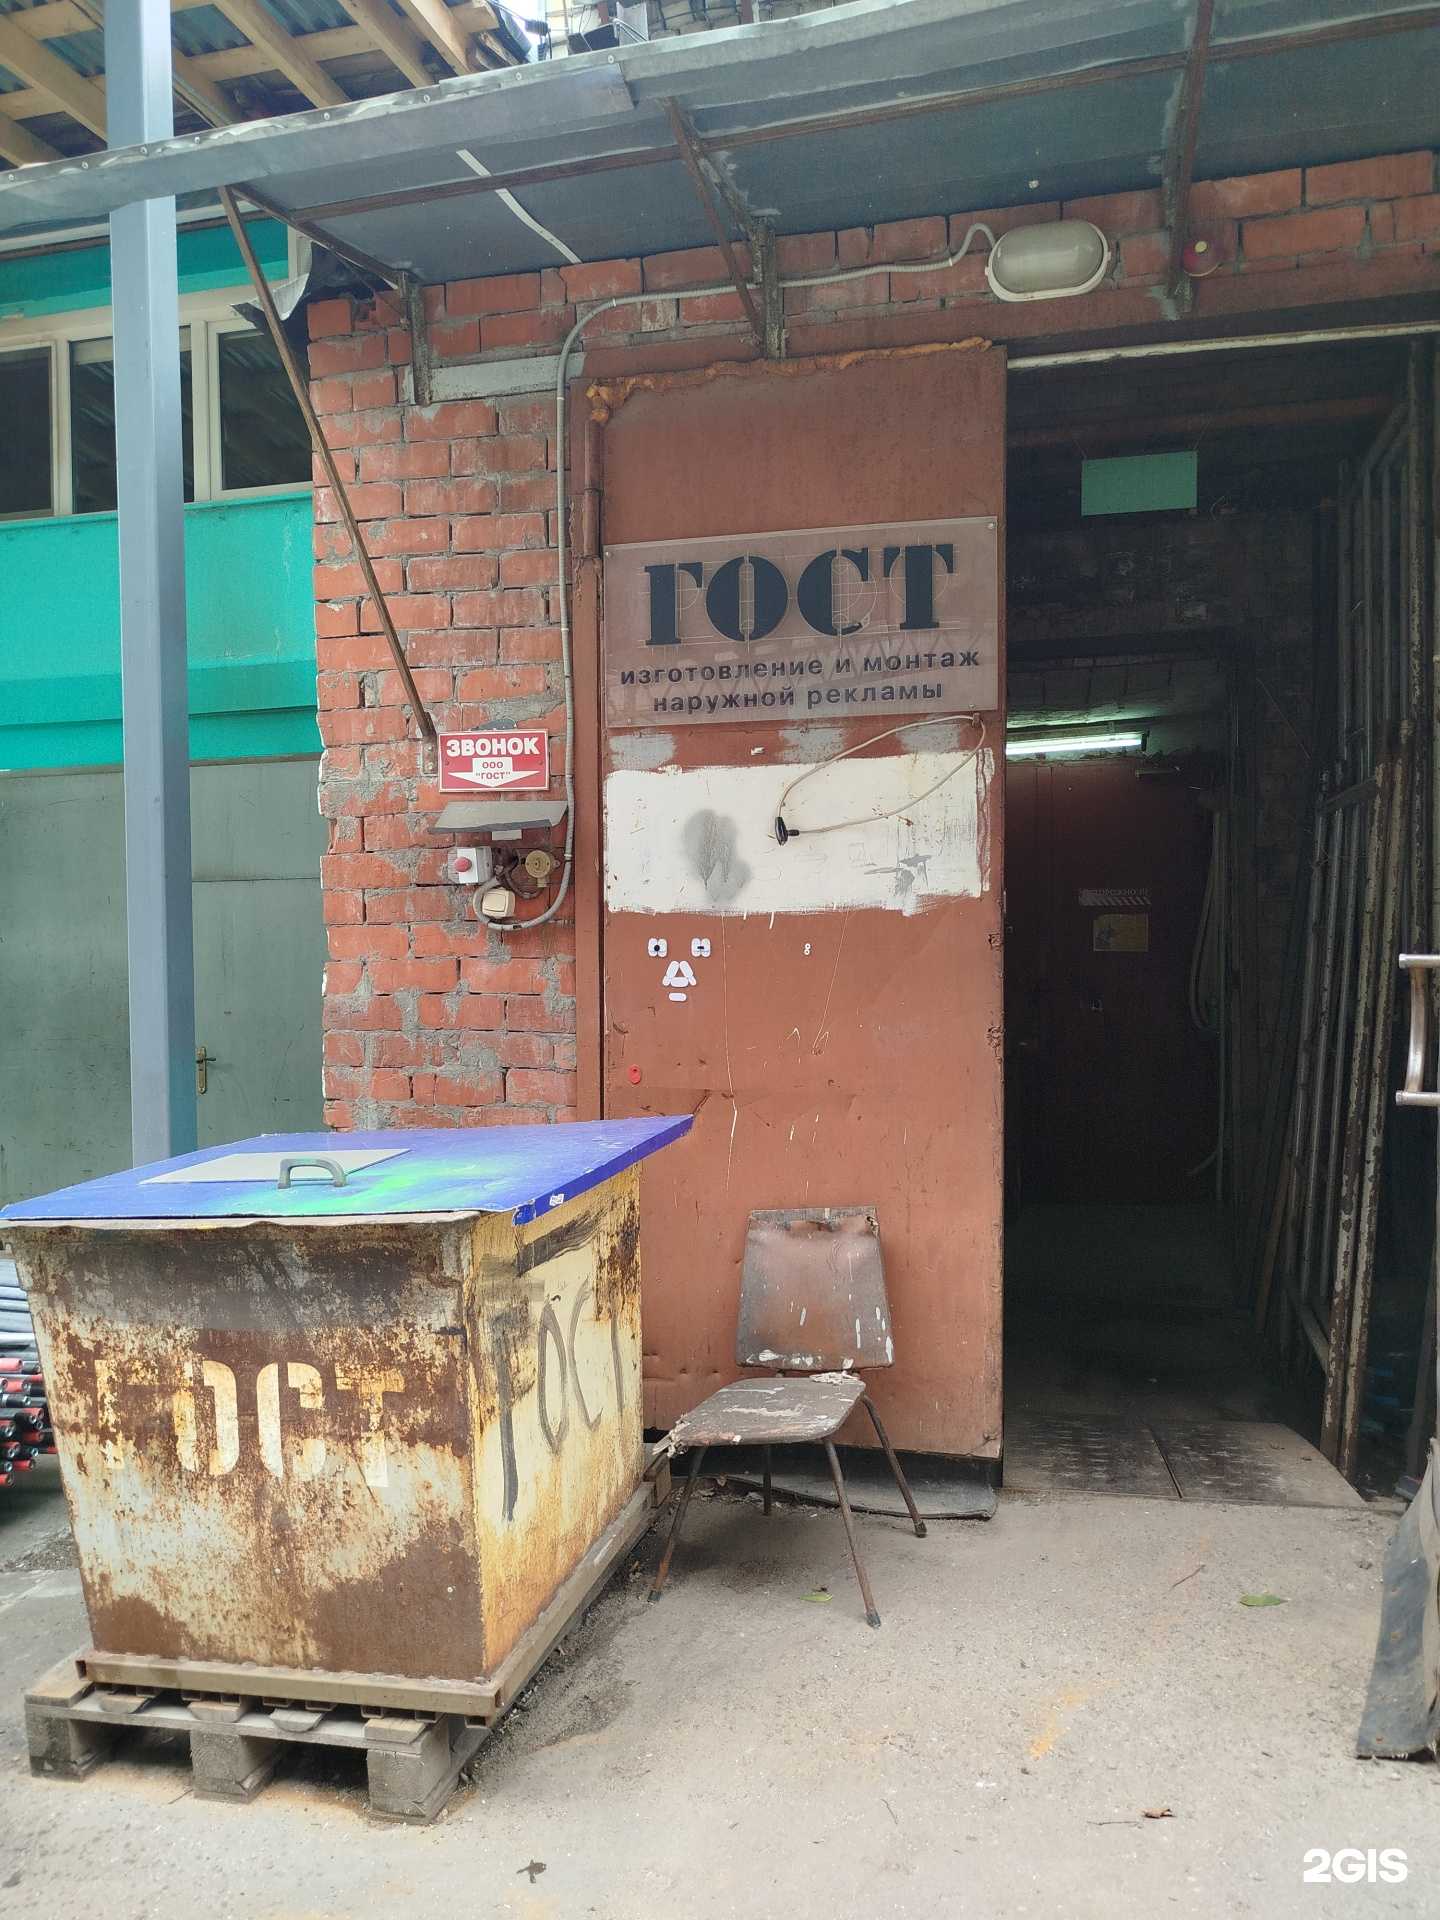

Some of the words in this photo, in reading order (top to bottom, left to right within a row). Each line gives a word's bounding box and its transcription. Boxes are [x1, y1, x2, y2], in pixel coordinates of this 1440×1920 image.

[644, 543, 954, 646] ГОСТ
[620, 655, 824, 686] изготовление
[835, 656, 852, 674] и
[863, 647, 980, 673] монтаж
[653, 686, 795, 714] наружной
[807, 684, 943, 710] рекламы
[446, 737, 540, 757] ЗВОНОК
[482, 761, 504, 769] ООО
